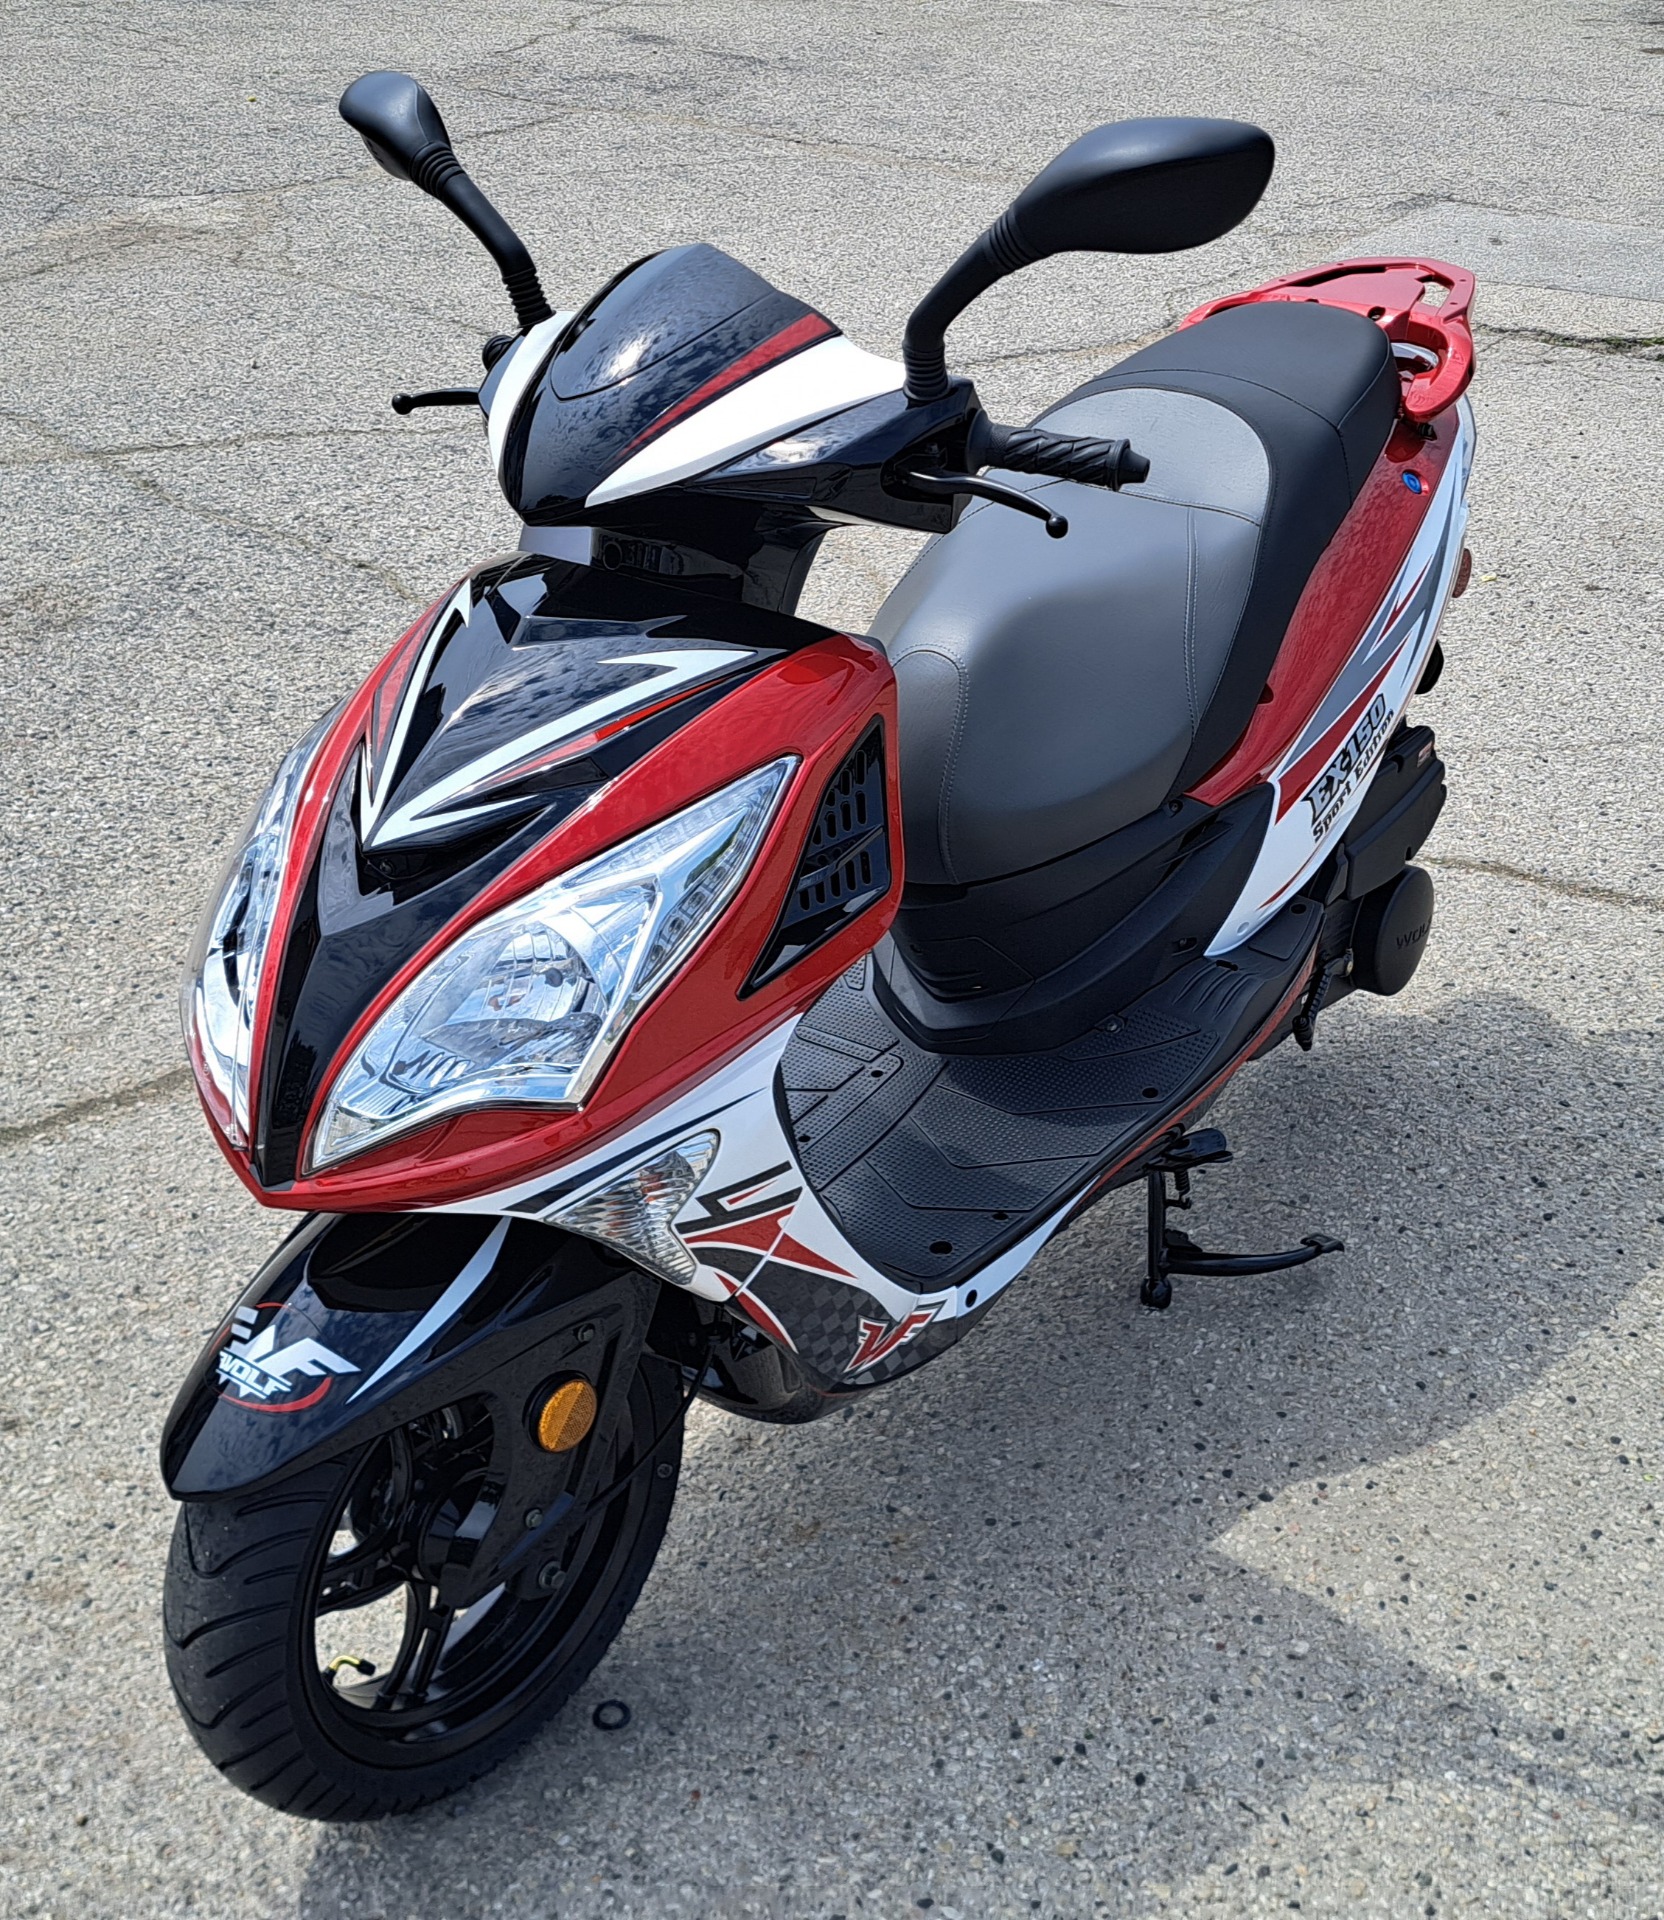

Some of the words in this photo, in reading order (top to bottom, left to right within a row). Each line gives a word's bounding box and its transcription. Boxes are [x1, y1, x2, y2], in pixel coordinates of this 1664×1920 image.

[1313, 786, 1351, 843] Sport
[1354, 709, 1394, 782] Edition
[219, 1350, 292, 1396] WOLF
